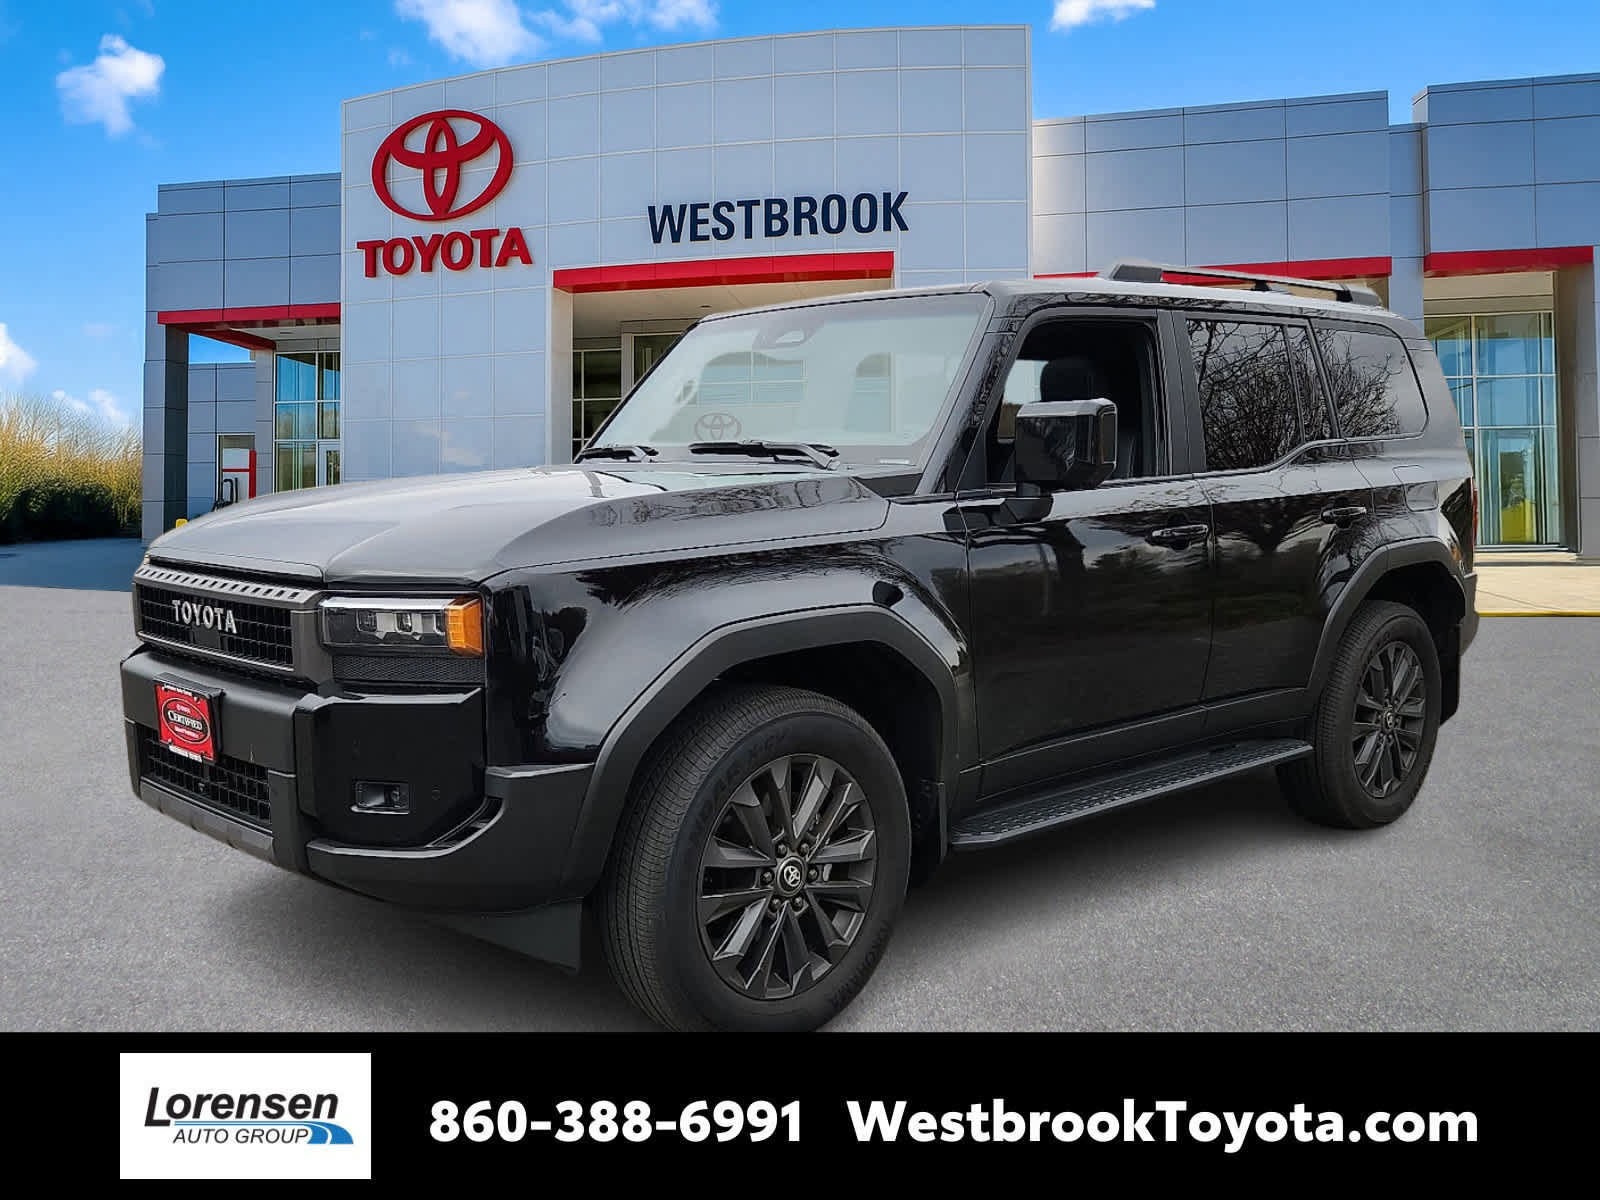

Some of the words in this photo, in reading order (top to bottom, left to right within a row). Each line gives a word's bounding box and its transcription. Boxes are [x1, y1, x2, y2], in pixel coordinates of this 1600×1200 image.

[648, 191, 909, 244] WESTBROOK
[357, 227, 533, 278] TOYOTA
[171, 599, 238, 634] TOYOTA
